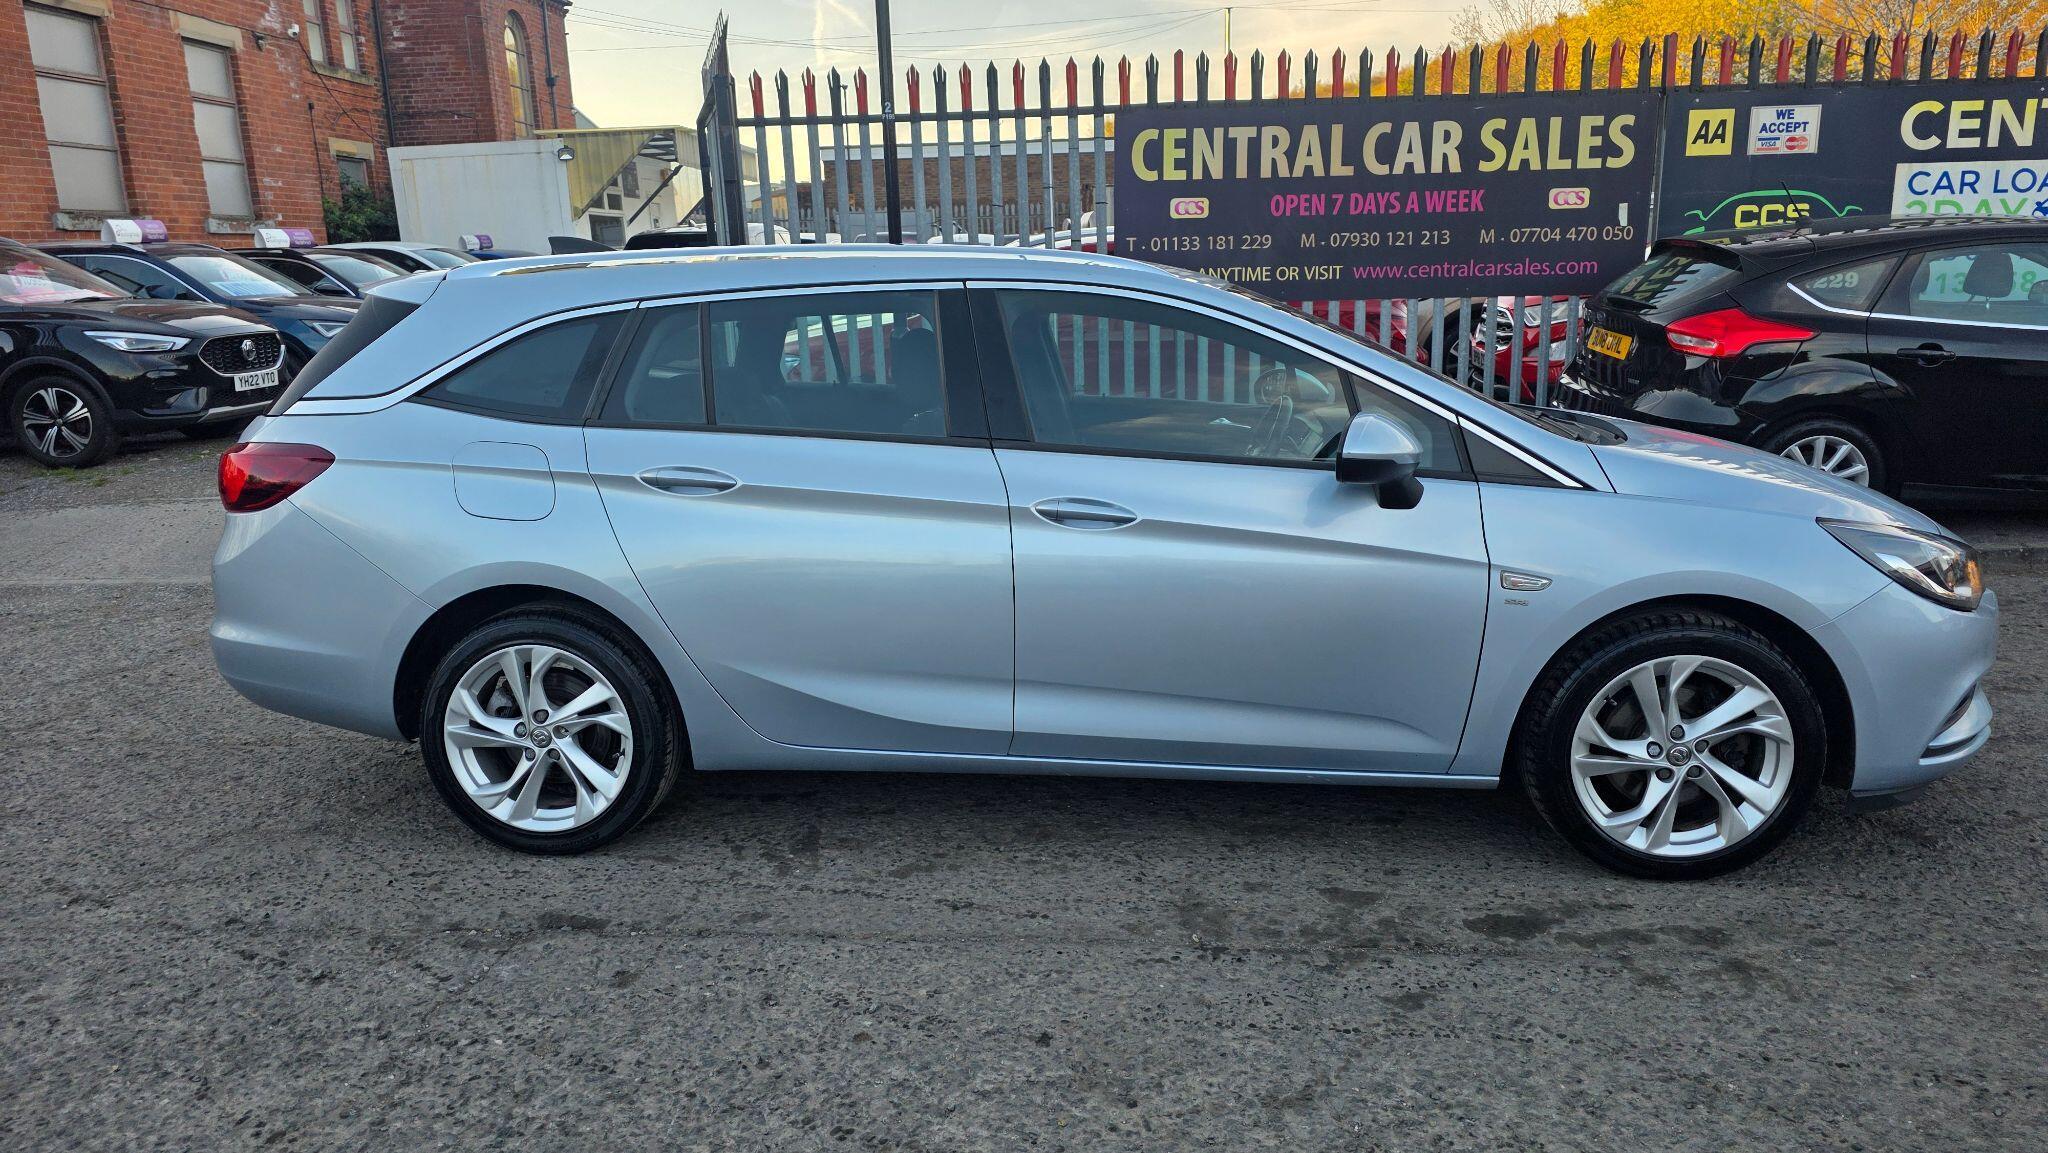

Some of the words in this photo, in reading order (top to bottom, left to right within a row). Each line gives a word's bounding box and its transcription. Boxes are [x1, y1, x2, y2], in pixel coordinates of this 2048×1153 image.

[1776, 109, 1795, 120] WE
[1901, 98, 2048, 150] CEN
[1691, 119, 1727, 144] AA
[1759, 121, 1809, 134] ACCEPT
[1131, 123, 1355, 182] CENTRAL
[1362, 120, 1463, 176] CAR
[1478, 114, 1636, 172] SALES
[1908, 170, 1981, 196] CAR
[1270, 194, 1326, 217] OPEN
[1332, 193, 1344, 216] 7
[1350, 191, 1401, 215] DAYS
[1405, 191, 1420, 214] A
[1425, 189, 1485, 213] WEEK
[1151, 236, 1200, 251] 01133
[1207, 235, 1235, 250] 181
[1240, 234, 1272, 249] 229
[1330, 231, 1380, 247] 07930
[1387, 230, 1414, 246] 121
[1420, 229, 1450, 245] 213
[1510, 228, 1561, 243] 07704
[1566, 226, 1598, 241] 470
[1602, 225, 1634, 240] 050
[1276, 266, 1299, 281] OR
[1304, 265, 1344, 280] VISIT
[1353, 258, 1598, 279] www.centralcarsales.com
[238, 374, 260, 388] YH22
